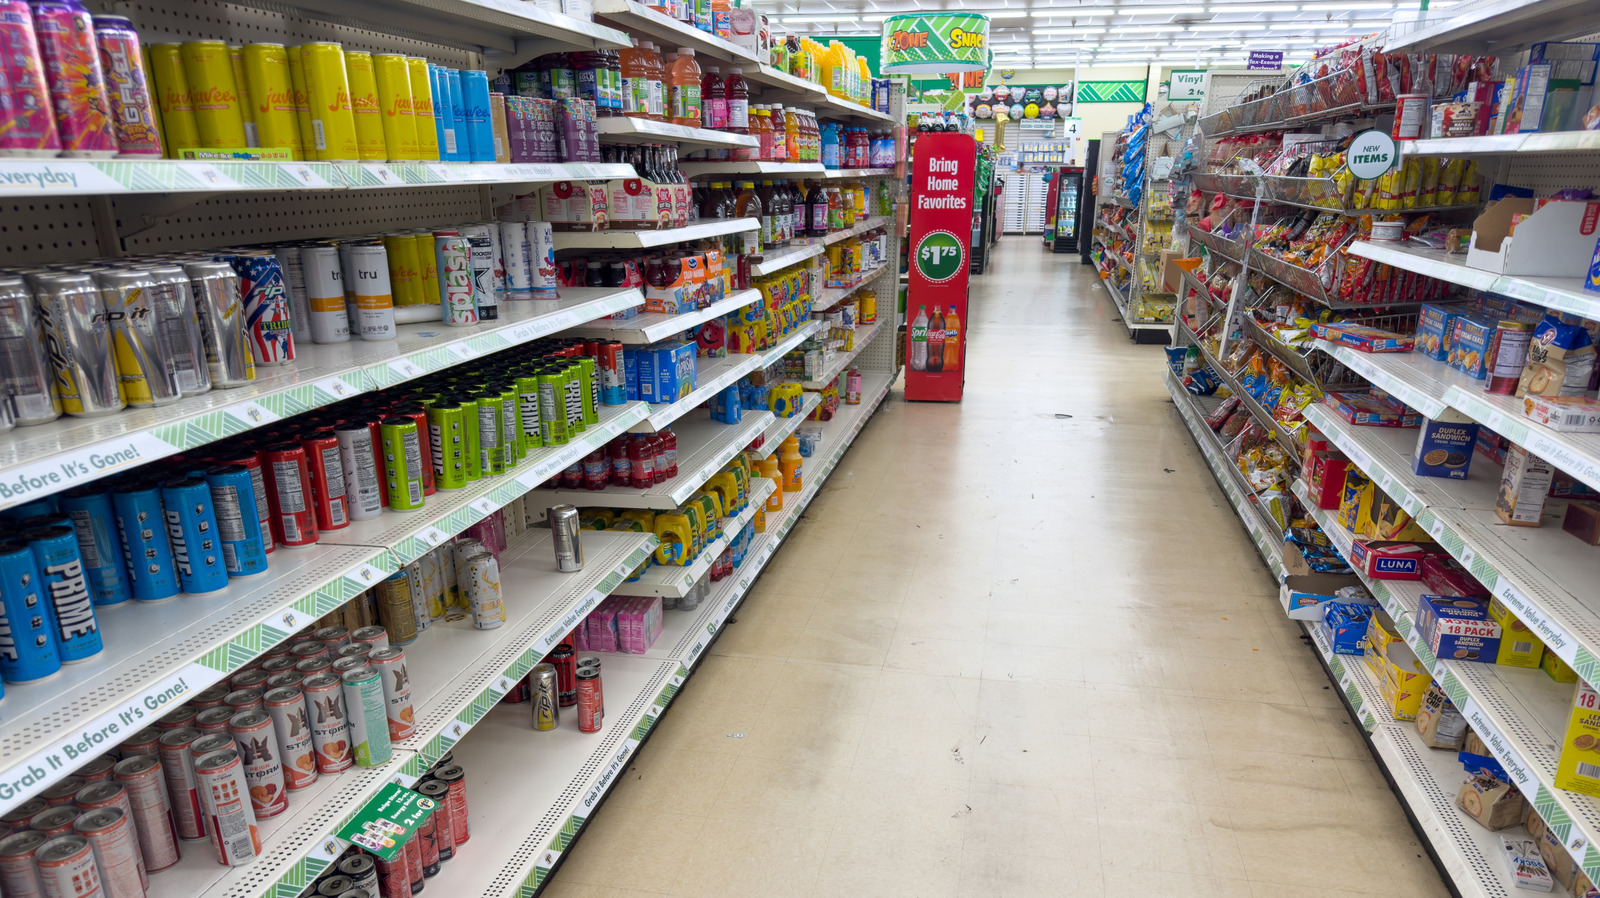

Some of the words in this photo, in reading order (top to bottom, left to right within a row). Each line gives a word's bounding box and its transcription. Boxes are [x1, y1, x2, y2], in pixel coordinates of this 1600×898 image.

[893, 30, 929, 51] ZONE
[114, 40, 138, 105] FUEL
[1178, 75, 1203, 83] Vinyl
[1069, 124, 1077, 134] 4
[1363, 145, 1380, 153] NEW
[929, 157, 958, 175] Bring
[1353, 153, 1388, 164] ITEMS
[0, 167, 77, 188] veryday
[927, 176, 958, 191] Home
[918, 194, 967, 210] Favorites
[359, 269, 377, 280] tru
[446, 239, 476, 324] splash
[253, 285, 284, 299] rip
[131, 306, 151, 321] it
[1428, 310, 1443, 321] VANILLA
[911, 327, 928, 338] Spri
[1466, 324, 1484, 337] VANILLA
[519, 392, 540, 438] PRIME
[1431, 432, 1471, 442] SANDWICH
[1439, 426, 1467, 435] DUPLEX
[430, 425, 444, 476] PRIME
[535, 466, 548, 478] New
[547, 460, 562, 472] Items
[560, 448, 578, 466] Weekly!
[1534, 439, 1551, 453] Grab
[1554, 449, 1575, 466] Before
[1575, 458, 1585, 472] It's
[1583, 466, 1600, 481] Gone
[0, 470, 60, 500] Before
[61, 459, 89, 480] It's
[90, 443, 141, 471] Gone!
[166, 510, 192, 577] PRIME
[1353, 544, 1365, 556] LUNA
[1381, 560, 1413, 569] LUNA
[45, 557, 98, 642] PRIME
[727, 592, 738, 608] CHOICES
[544, 625, 565, 647] Extreme
[563, 613, 577, 631] Value
[574, 596, 596, 618] Everyday
[1502, 588, 1526, 613] Extreme
[1524, 607, 1540, 627] Value
[1538, 621, 1567, 650] Everyday
[1448, 626, 1461, 635] 18
[1464, 626, 1495, 637] PACK
[691, 641, 703, 657] ITEMS
[1319, 635, 1330, 655] Everyday
[540, 678, 550, 693] it
[1426, 698, 1441, 709] CHIP
[1428, 690, 1443, 703] BAG
[1580, 693, 1595, 709] 18
[538, 691, 551, 720] rip
[323, 721, 341, 729] REIGN
[1579, 718, 1600, 727] SAND
[0, 764, 46, 801] Grab
[46, 753, 64, 771] It
[62, 720, 121, 761] Before
[118, 706, 144, 727] It's
[143, 677, 191, 711] Gone!
[1470, 712, 1491, 738] Extreme
[1490, 733, 1504, 754] Value
[1502, 749, 1529, 784] Everyday
[249, 763, 270, 771] REIGN
[584, 793, 597, 809] Grab
[597, 771, 611, 794] Before
[608, 762, 619, 777] It's
[615, 745, 630, 767] Gone!
[395, 791, 410, 804] 12-oz.
[377, 800, 390, 812] Reign
[390, 805, 407, 820] Energy
[405, 793, 418, 808] Drinks
[403, 816, 415, 827] 2
[411, 809, 424, 820] for
